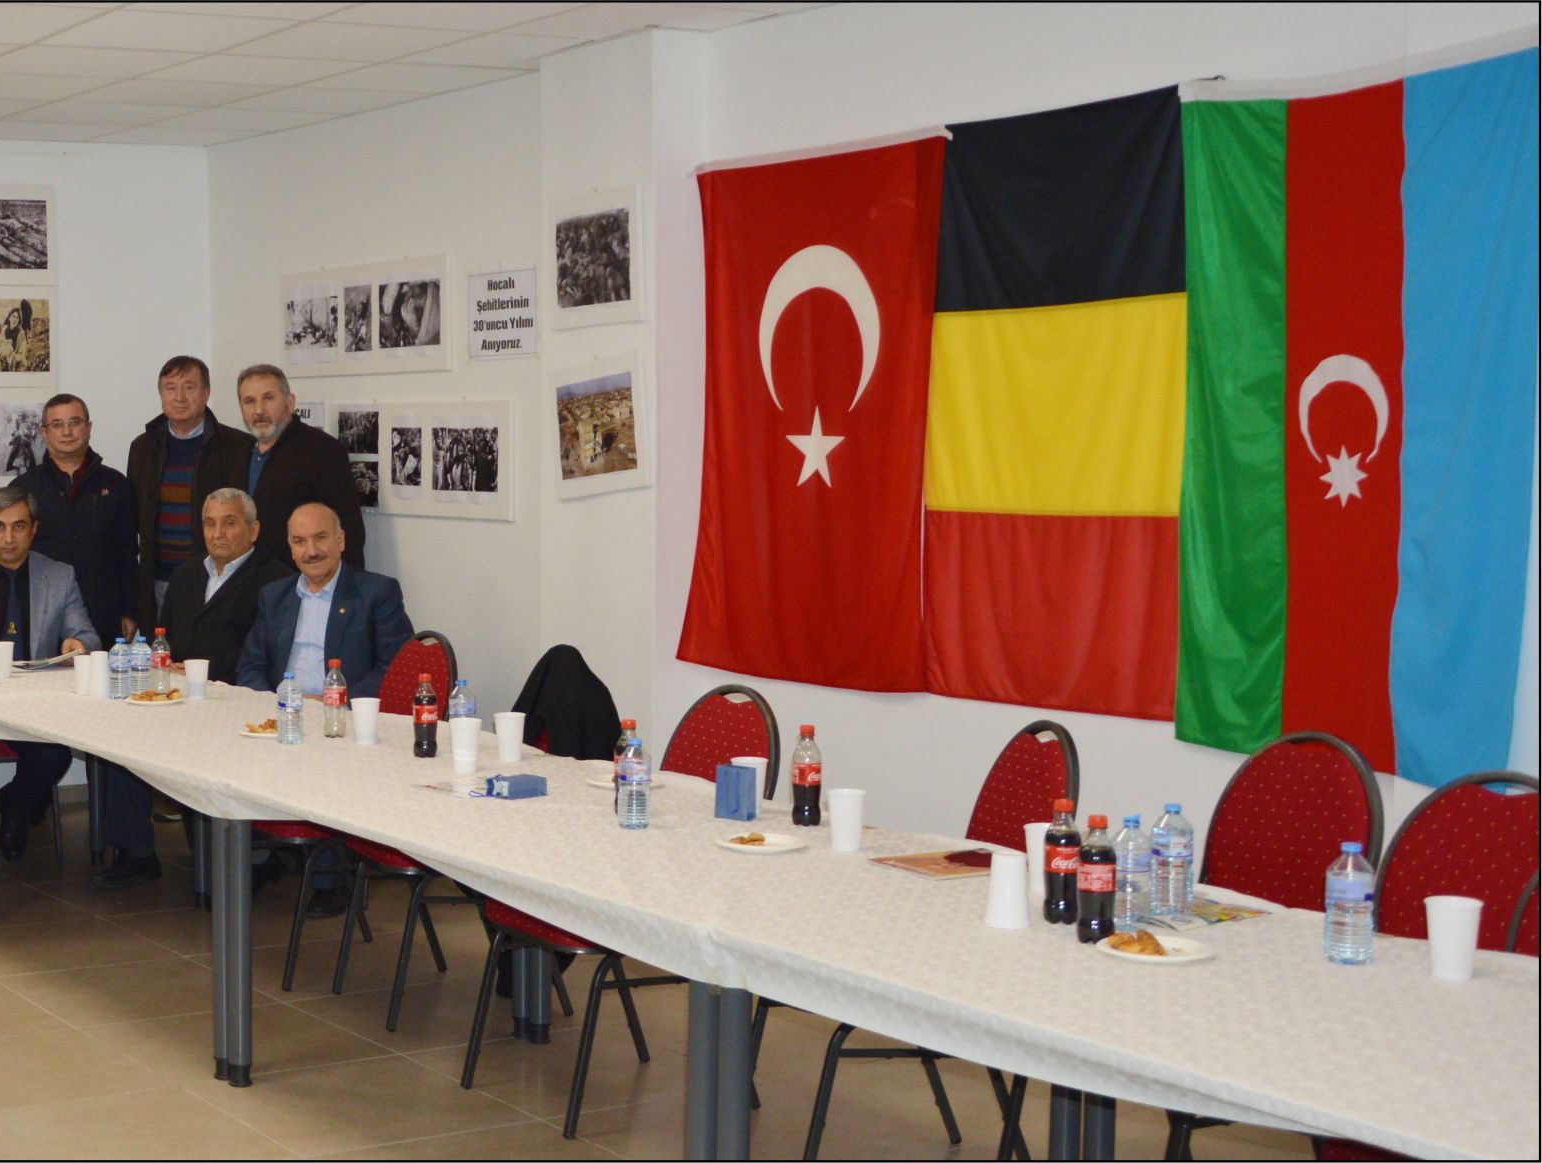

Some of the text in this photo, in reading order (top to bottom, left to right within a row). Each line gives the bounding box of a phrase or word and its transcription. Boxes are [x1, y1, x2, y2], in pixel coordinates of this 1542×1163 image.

[487, 277, 515, 291] Hocalı
[476, 296, 529, 315] Şehitlerinin
[473, 316, 534, 332] 30'uncu Yılını
[481, 339, 523, 352] Anıyoruz.
